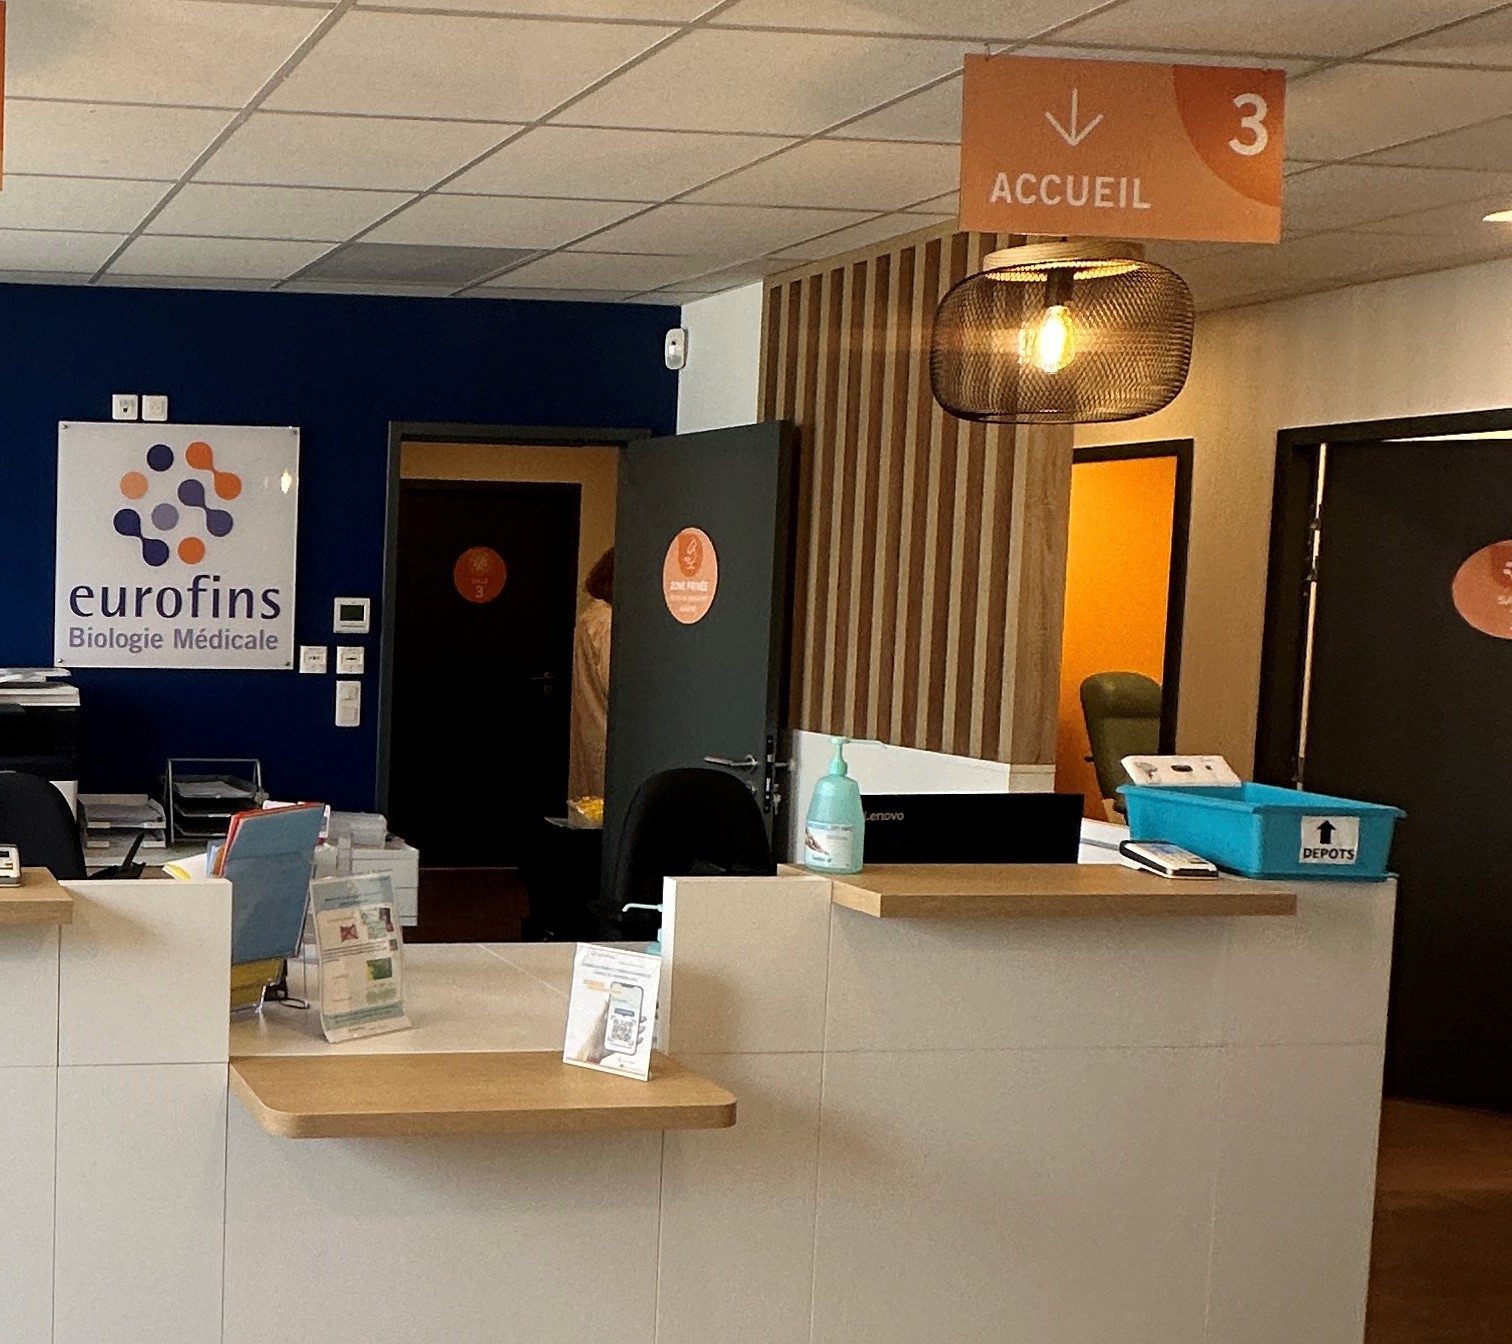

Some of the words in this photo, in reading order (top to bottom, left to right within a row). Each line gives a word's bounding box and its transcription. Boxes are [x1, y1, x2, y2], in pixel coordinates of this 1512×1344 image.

[1228, 93, 1268, 156] 3
[990, 172, 1151, 209] ACCUEIL
[69, 574, 281, 620] eurofins
[69, 626, 164, 654] Biologie
[173, 627, 279, 651] Médicale
[864, 811, 905, 821] Lenovo
[1303, 848, 1355, 860] DEPOTS
